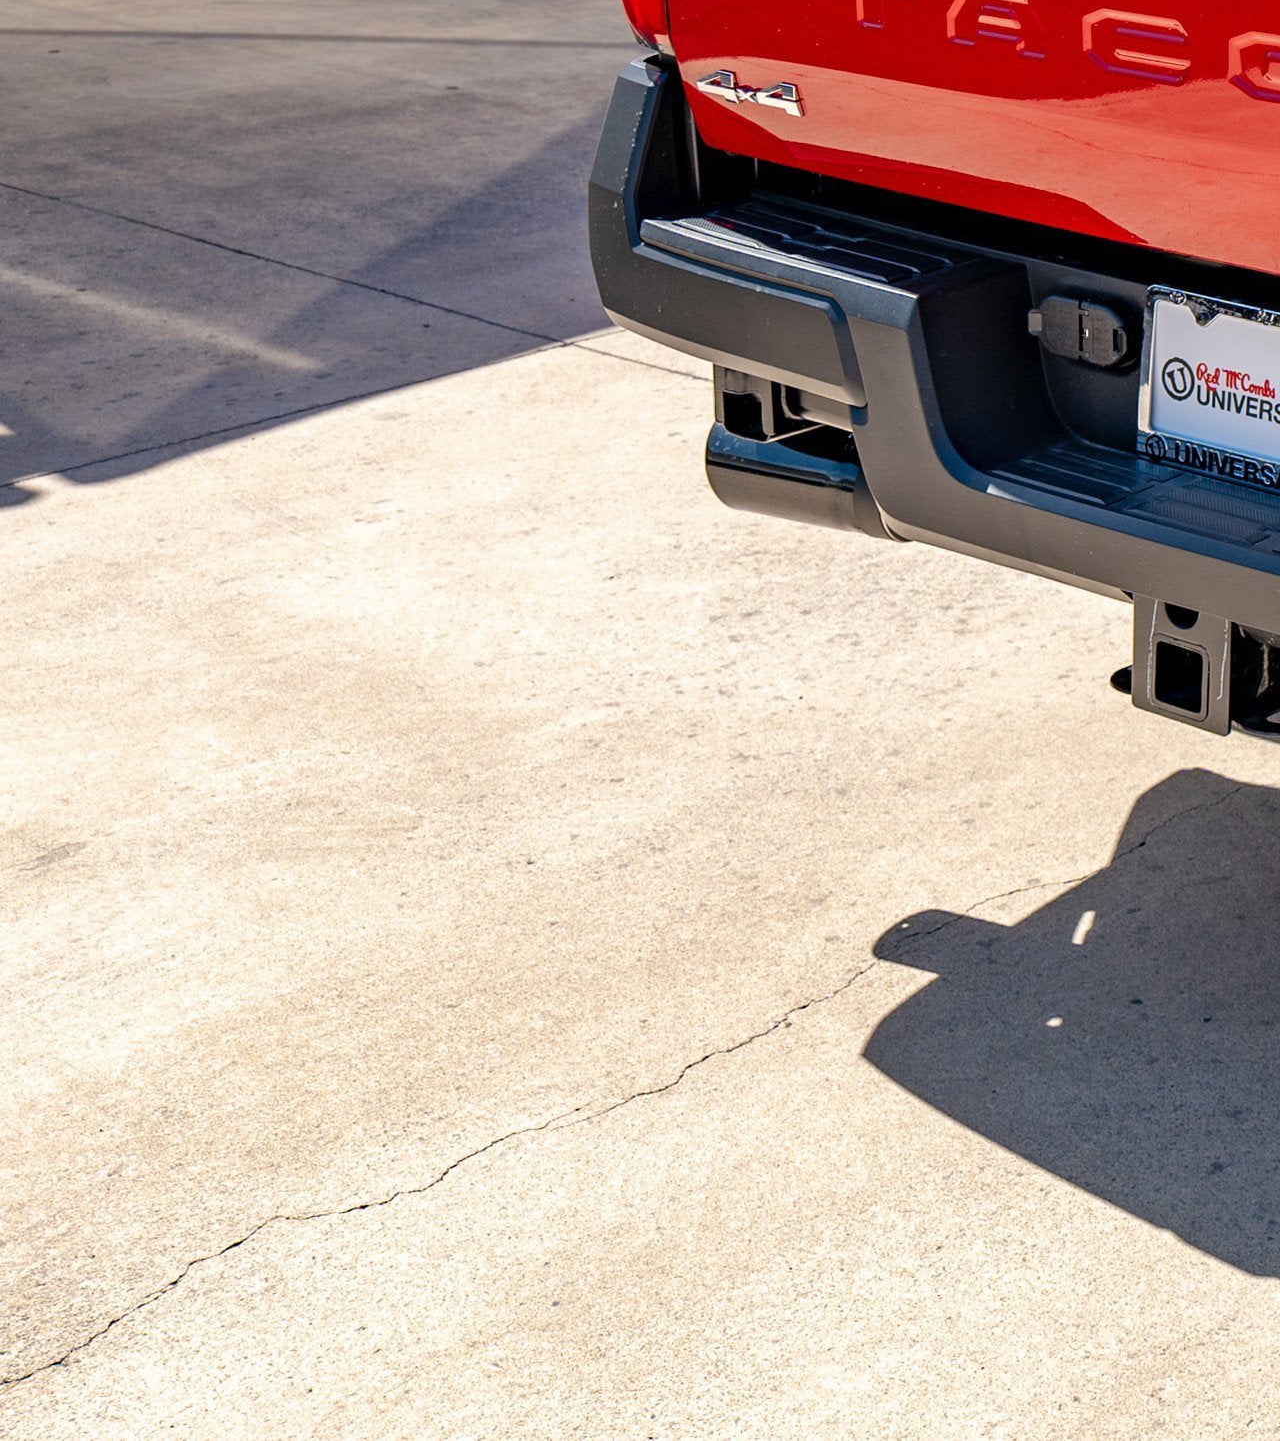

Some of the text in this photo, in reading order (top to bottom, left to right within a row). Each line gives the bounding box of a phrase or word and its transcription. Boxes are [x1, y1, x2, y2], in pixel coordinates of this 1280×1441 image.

[696, 68, 804, 117] 4x4
[1196, 362, 1276, 399] Red McCombs
